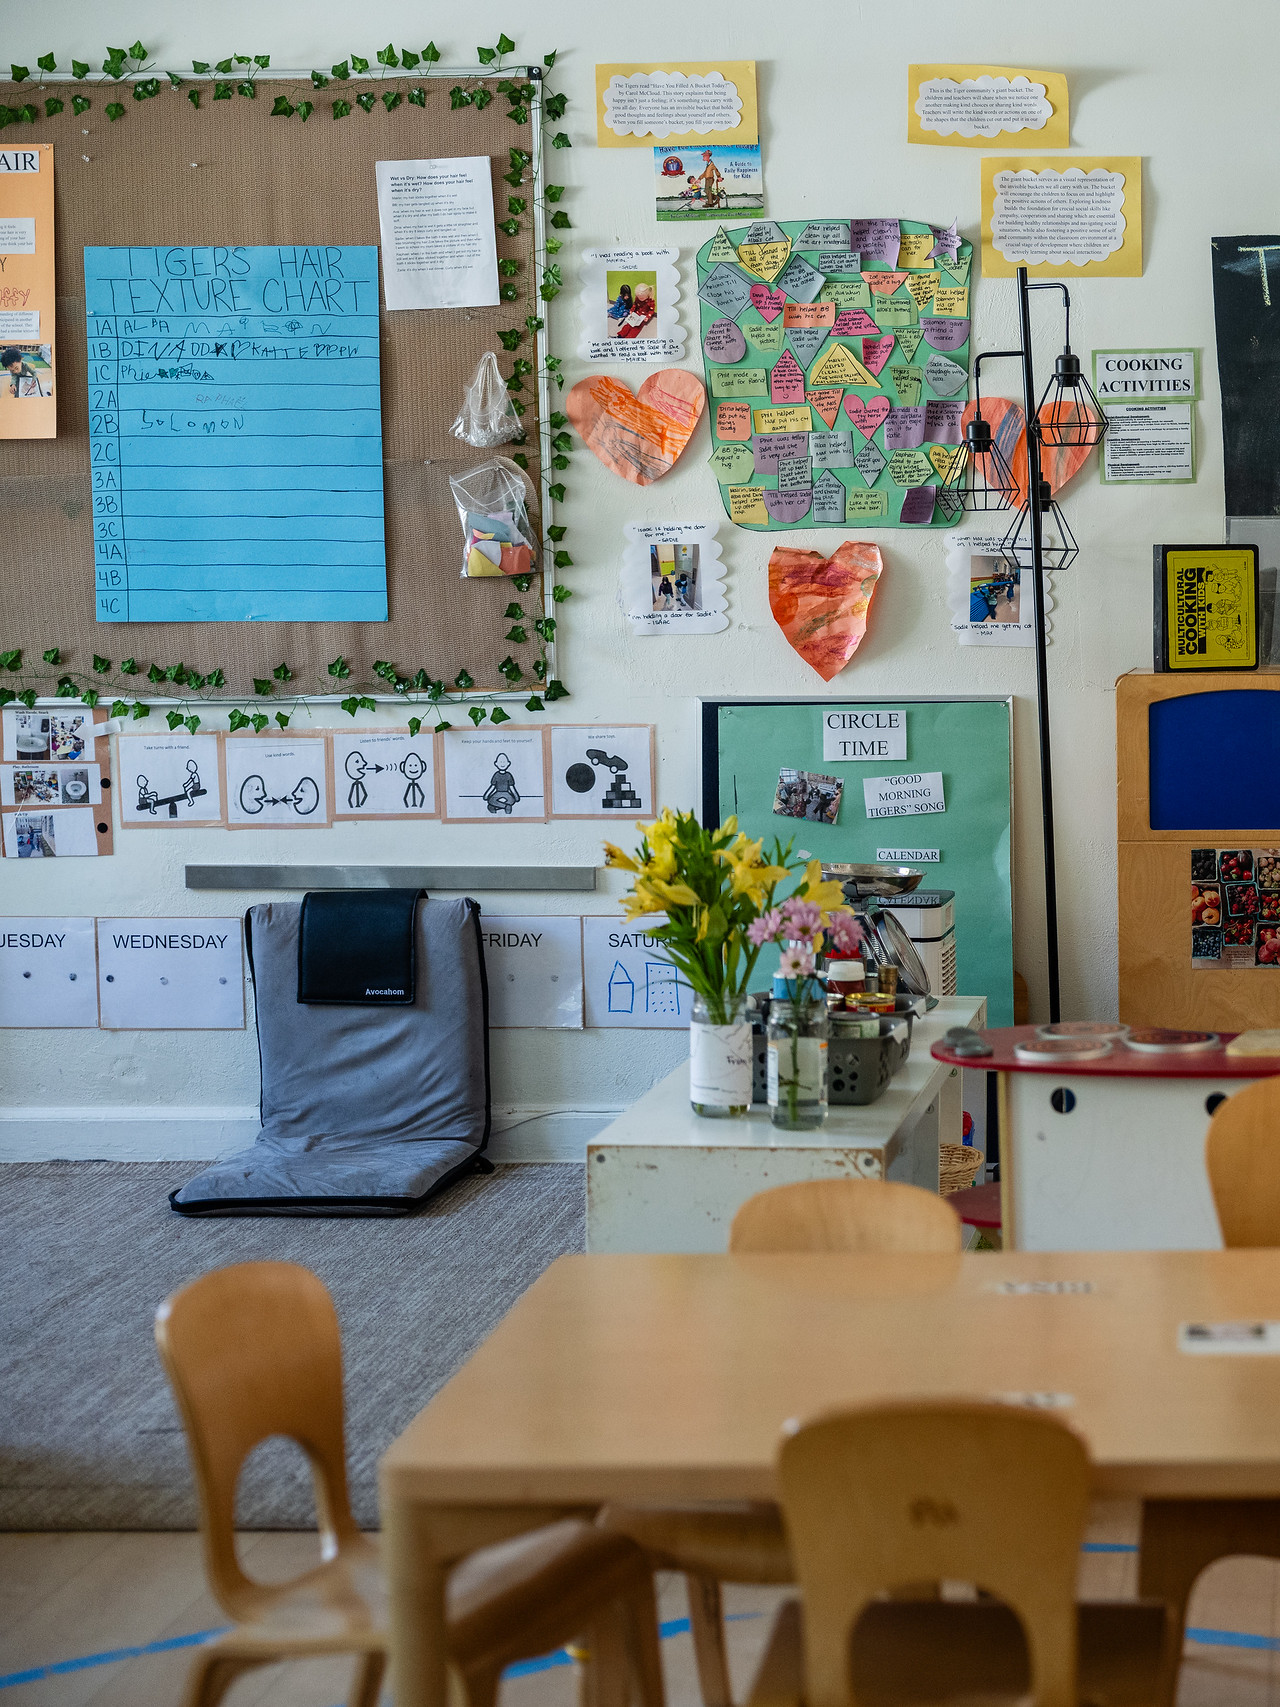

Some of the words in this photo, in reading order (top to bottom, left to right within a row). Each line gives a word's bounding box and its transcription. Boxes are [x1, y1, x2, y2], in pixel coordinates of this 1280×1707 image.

[109, 247, 251, 277] TIGERS
[279, 247, 344, 278] HAIR
[96, 278, 251, 313] TEXTURE
[262, 278, 370, 313] CHART
[95, 319, 113, 335] 1A
[92, 342, 111, 358] 1B
[95, 365, 111, 381] 1C
[1106, 359, 1182, 371] COOKING
[1099, 379, 1190, 392] ACTIVITIES
[94, 391, 117, 409] 2A
[93, 415, 119, 434] 2B
[93, 443, 116, 462] 2C
[95, 471, 116, 488] 3A
[96, 496, 118, 513] 3B
[98, 522, 118, 538] 3C
[99, 543, 123, 559] 4A
[99, 570, 121, 587] 4B
[101, 599, 120, 614] 4C
[1177, 568, 1186, 655] MULTICULTURAL
[1185, 568, 1197, 655] COOKING
[1198, 610, 1206, 638] WITH
[827, 713, 900, 729] CIRCLE
[839, 740, 888, 756] TIME
[879, 788, 931, 801] MORNING
[914, 801, 944, 813] SONG
[878, 851, 938, 860] CALENDAR
[113, 935, 228, 948] WEDNESDAY
[481, 933, 543, 947] FRIDAY
[365, 988, 405, 996] Avocahom
